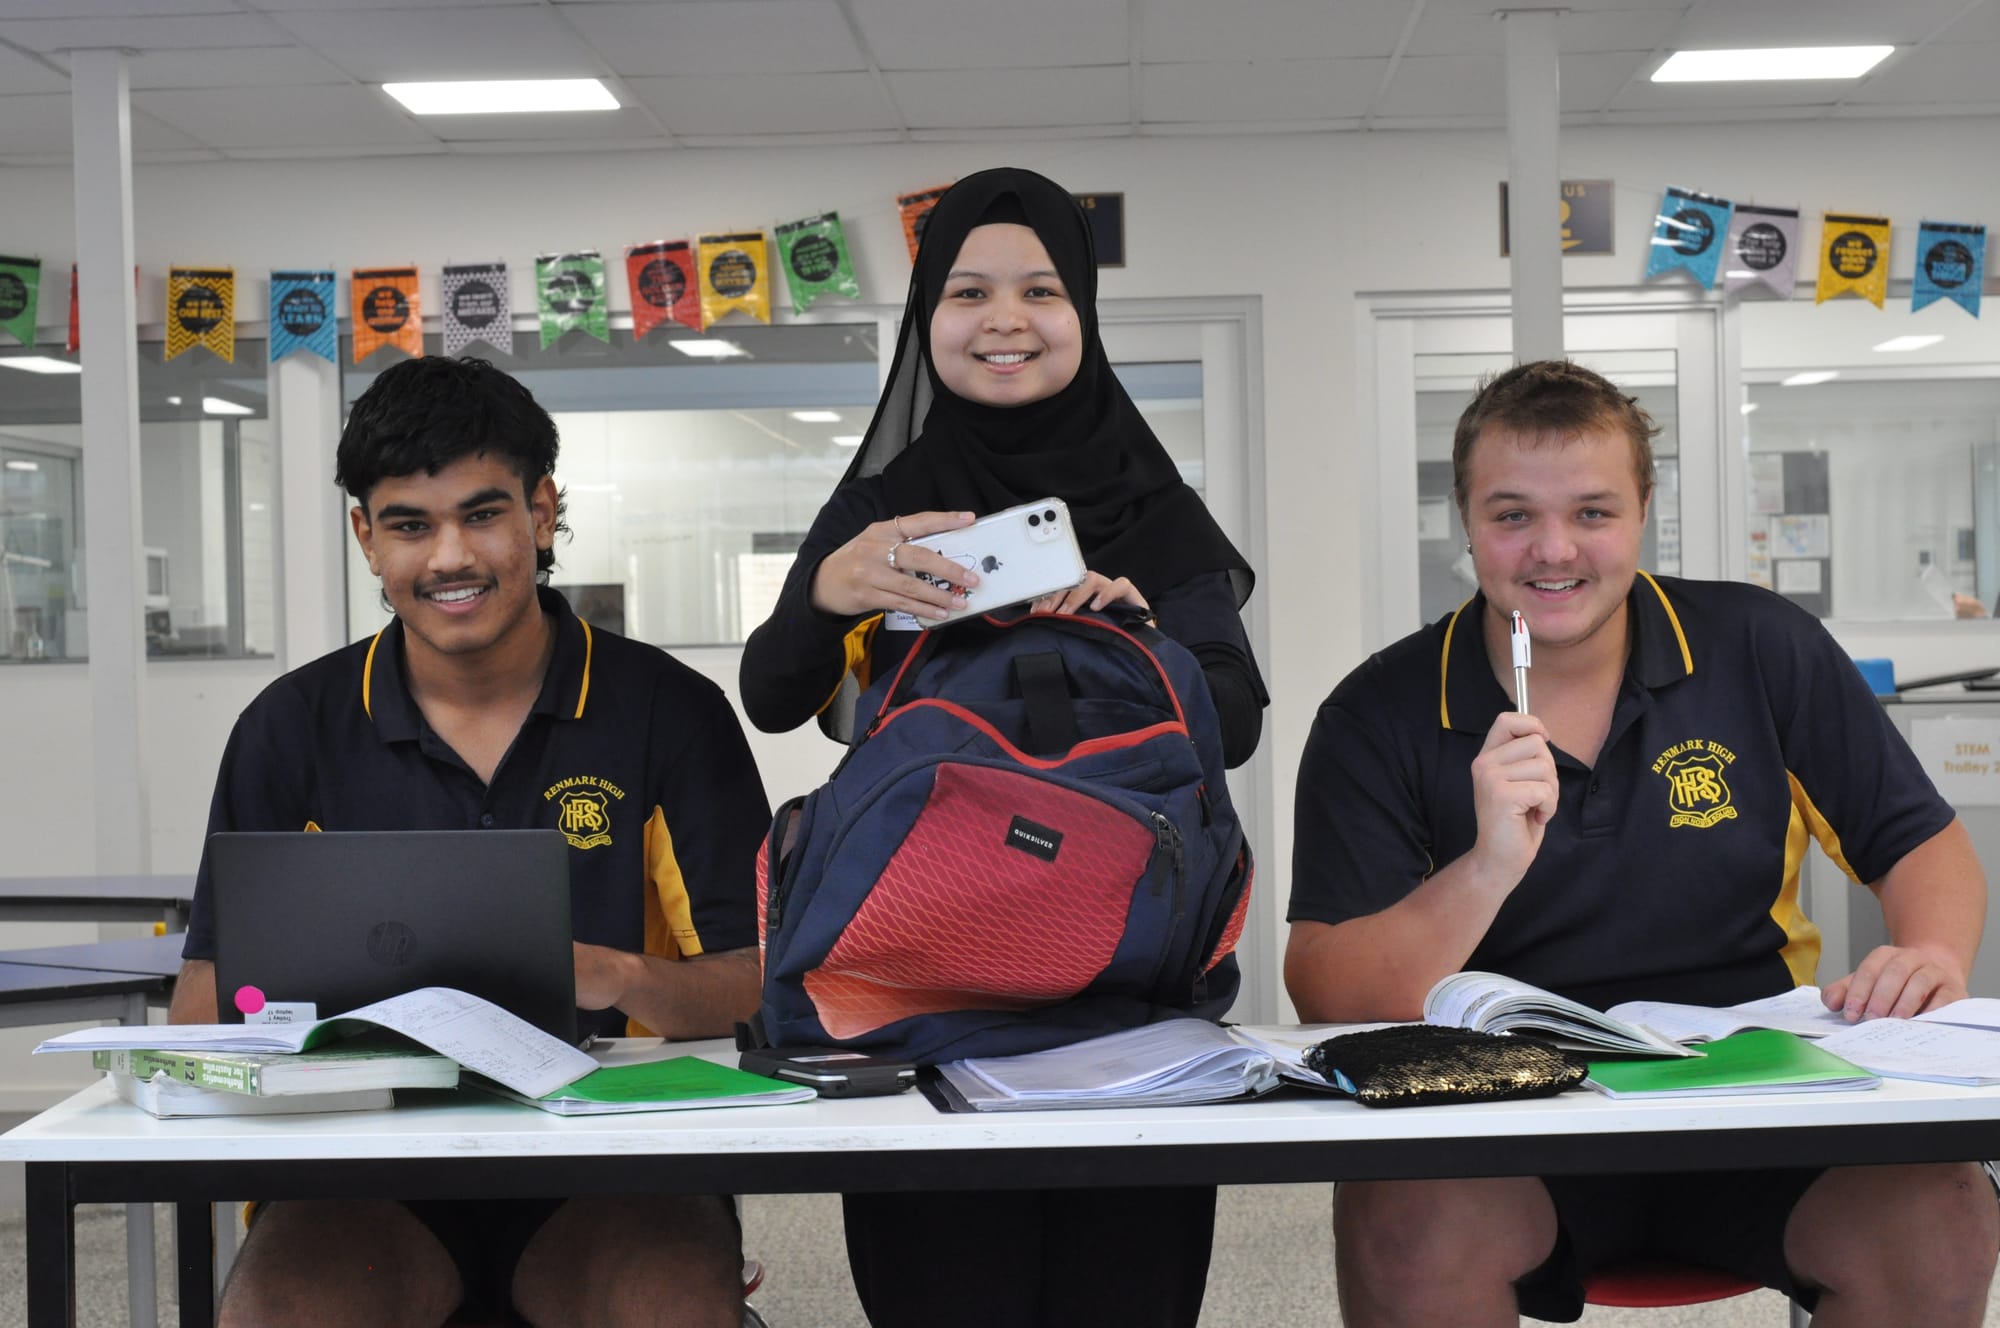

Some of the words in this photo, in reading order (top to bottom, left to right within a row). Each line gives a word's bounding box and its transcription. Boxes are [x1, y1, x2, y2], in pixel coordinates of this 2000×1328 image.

[1564, 184, 1586, 198] US
[280, 313, 323, 325] LEARN
[1651, 739, 1704, 774] RENMARK
[1707, 740, 1737, 765] HIGH
[1955, 743, 1991, 756] STEM
[1944, 760, 1989, 776] Trolley
[543, 775, 597, 801] RENMARK
[598, 778, 626, 800] HIGH
[1014, 828, 1054, 849] QUIKSILVER
[184, 1061, 196, 1082] 12
[202, 1062, 232, 1077] Australia
[202, 1073, 245, 1090] Mathematics
